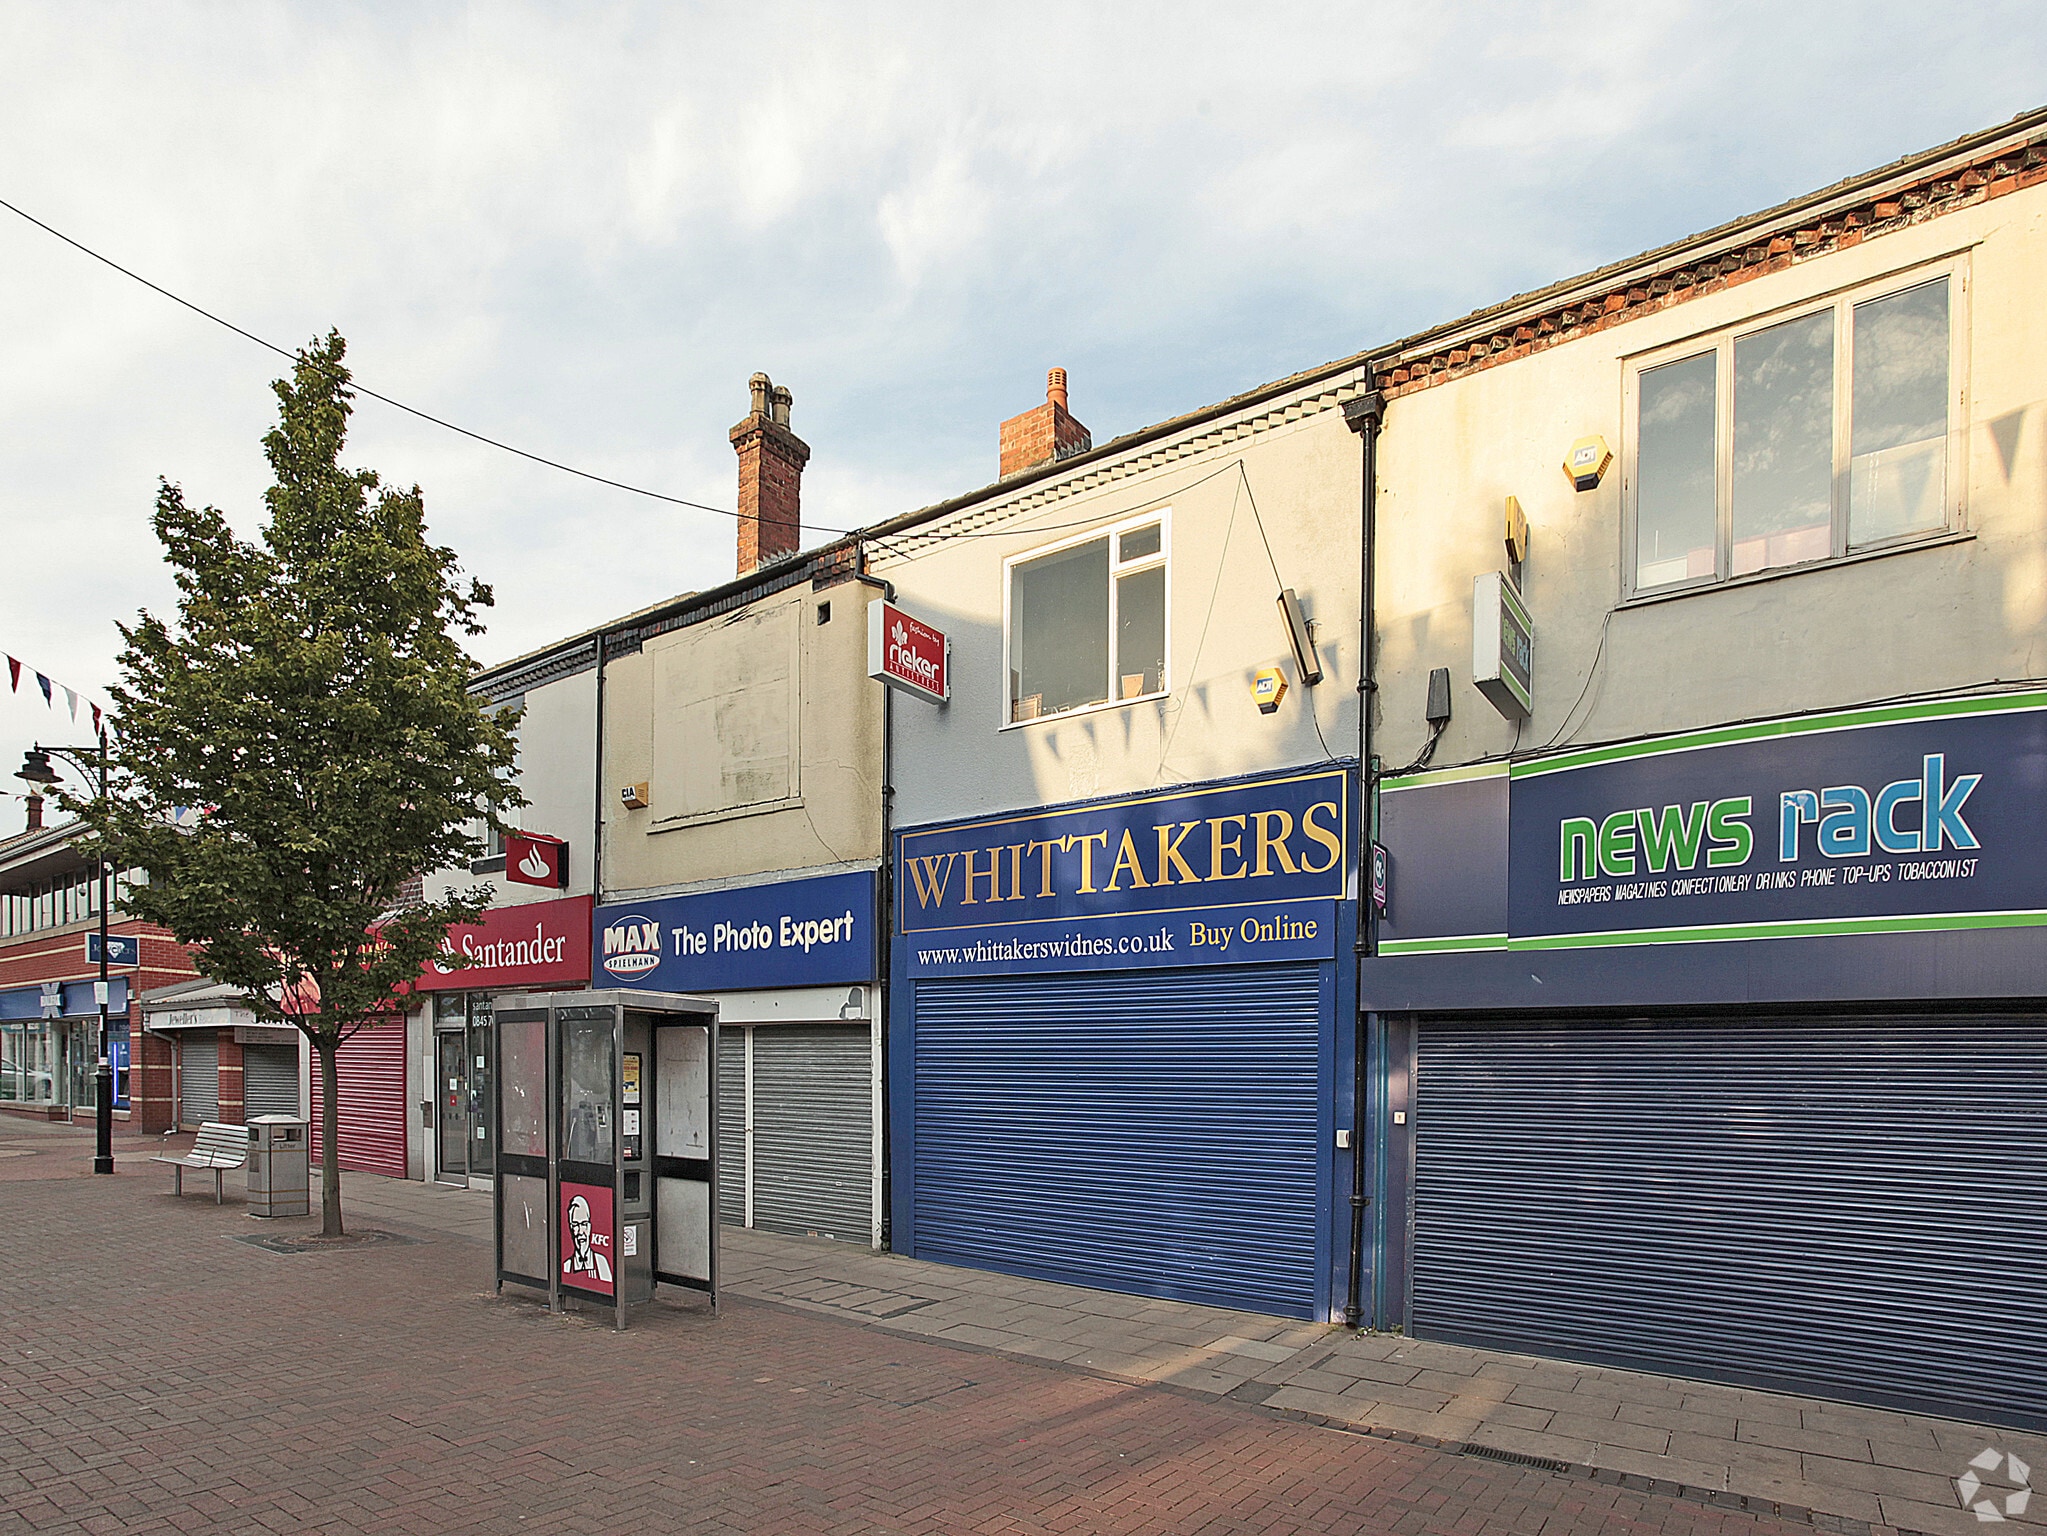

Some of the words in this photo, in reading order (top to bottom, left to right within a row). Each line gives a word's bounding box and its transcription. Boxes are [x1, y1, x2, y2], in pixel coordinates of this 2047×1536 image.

[1575, 449, 1594, 462] ADT
[889, 643, 940, 679] rieker
[1257, 680, 1273, 692] ADT
[1779, 752, 1983, 862] rack
[905, 801, 1341, 909] WHITTAKERS
[1557, 885, 1612, 906] NEWSPAPERS
[1614, 880, 1668, 901] MAGAZINES
[1671, 873, 1753, 897] CONFECTIONERY
[1755, 870, 1796, 890] DRINKS
[1800, 867, 1837, 887] PHONE
[1842, 863, 1892, 885] TOP-UPS
[1897, 858, 1979, 881] TOBACCONIST
[462, 922, 566, 971] Santander
[603, 922, 660, 955] MAX
[671, 925, 707, 956] The
[713, 920, 773, 953] Photo
[779, 910, 854, 954] Expert
[917, 927, 1174, 966] www.whittakerswidnes.co.uk
[1189, 921, 1234, 951] Buy
[1240, 914, 1318, 943] Online
[608, 956, 655, 969] SPIELMANN
[472, 1015, 488, 1027] 0845
[590, 1233, 610, 1247] KFC
